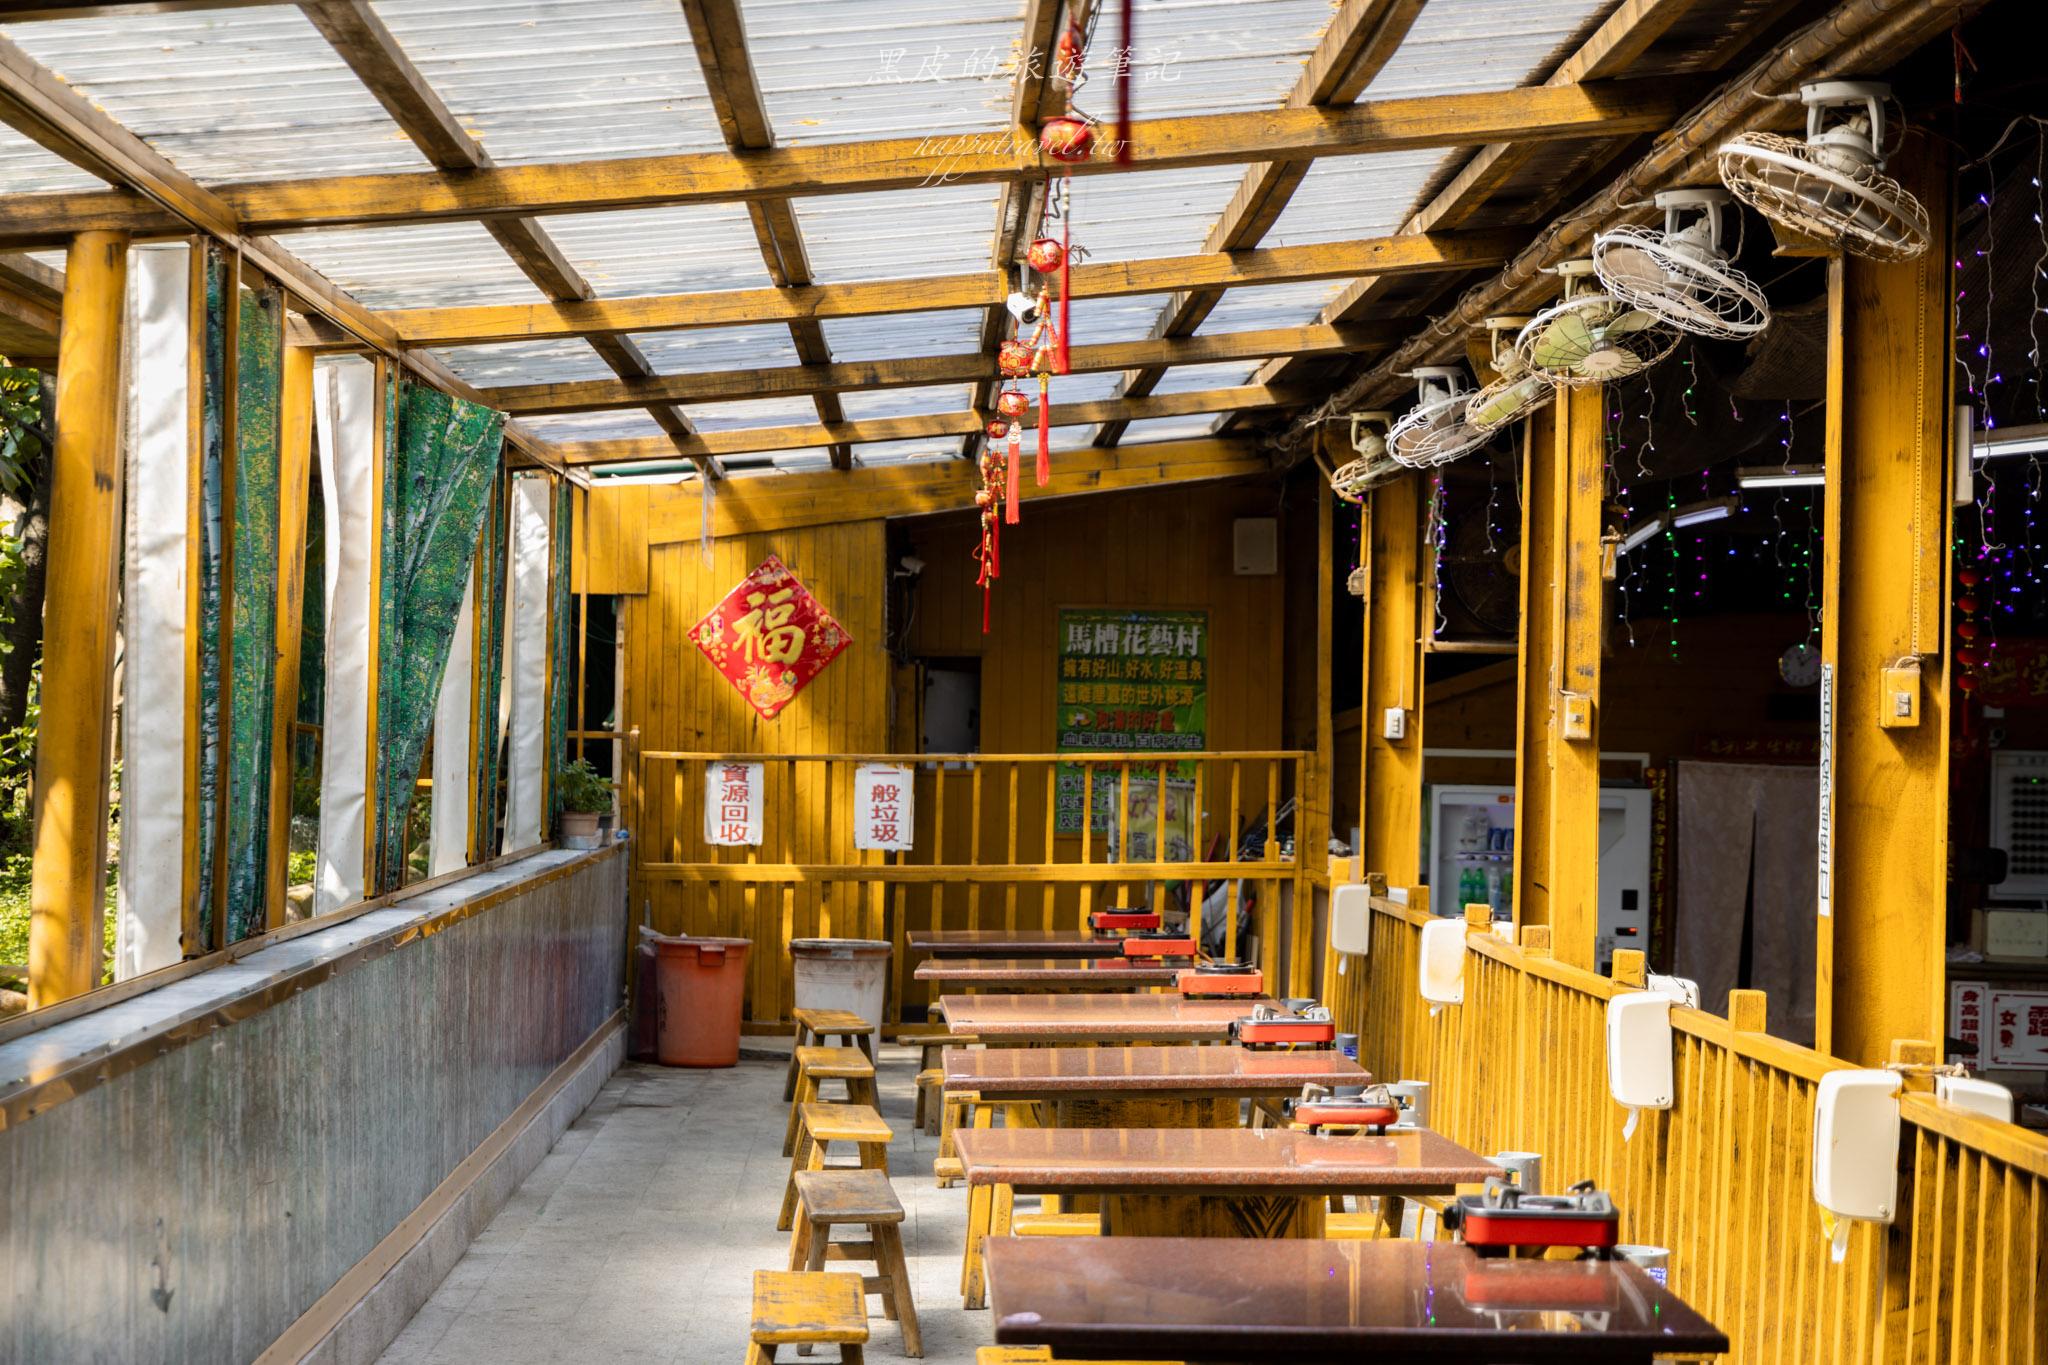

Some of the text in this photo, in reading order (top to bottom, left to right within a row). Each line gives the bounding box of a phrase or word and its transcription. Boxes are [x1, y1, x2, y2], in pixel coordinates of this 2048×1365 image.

[731, 586, 806, 665] 福
[1066, 622, 1201, 657] 馬槽花藝村
[719, 763, 750, 844] 資源回收
[870, 769, 901, 843] 一般垃圾
